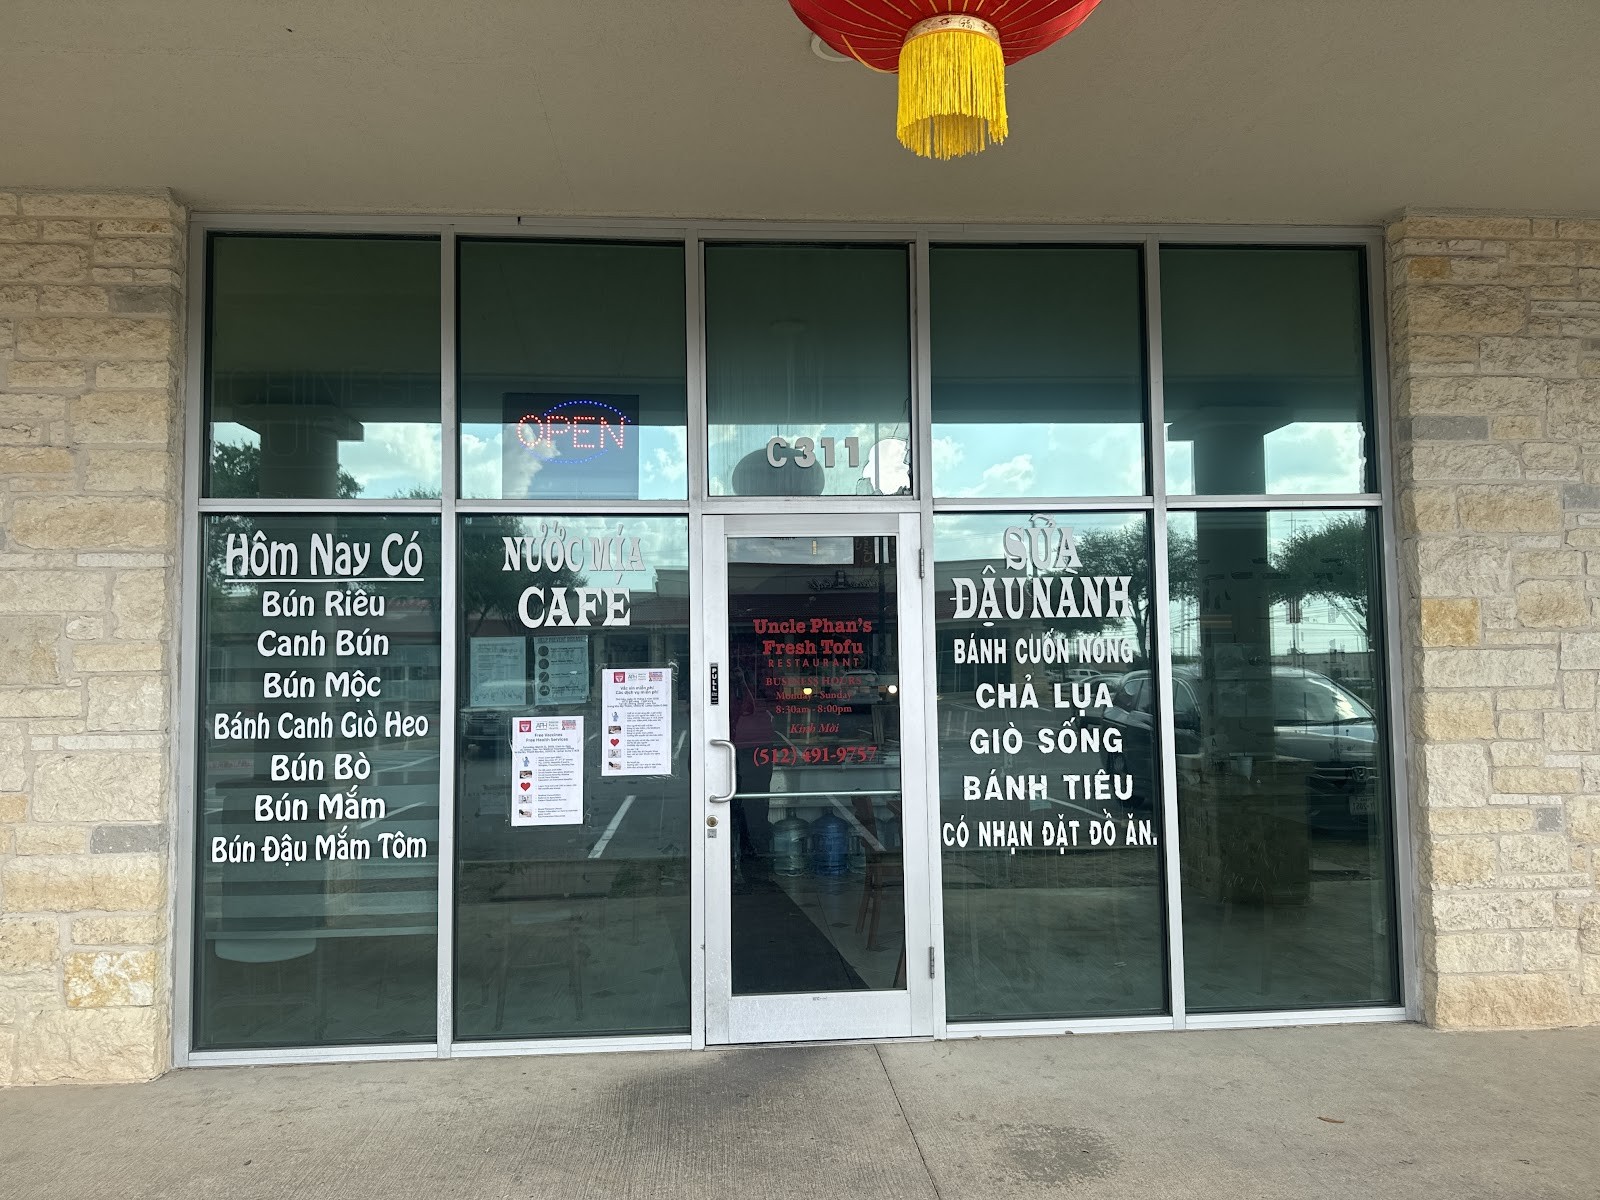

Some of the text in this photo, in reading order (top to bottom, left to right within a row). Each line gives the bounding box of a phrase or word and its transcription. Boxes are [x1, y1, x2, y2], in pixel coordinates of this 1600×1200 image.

[515, 413, 625, 450] OPEN
[226, 530, 423, 576] Hôm Nay Có
[502, 521, 646, 573] NƯỚC MÍA
[262, 589, 385, 617] Bún Riêu
[753, 618, 873, 634] Uncle Phan's
[257, 628, 389, 657] Canh Bún
[762, 639, 864, 655] Fresh Tofu
[953, 633, 1007, 664] BÁNH
[1015, 628, 1069, 664] CUỐN
[768, 657, 859, 668] RESTAURANT
[263, 670, 381, 703] Bún Mộc
[766, 676, 862, 686] BUSINESS HOURS
[776, 691, 812, 702] Monday
[819, 690, 852, 701] Sunday
[975, 674, 1113, 716] CHẢ LỤA
[214, 710, 429, 739] Bánh Canh Giò Heo
[776, 705, 810, 714] 8:30am
[817, 704, 852, 715] 8:00pm
[969, 717, 1123, 754] GIÒ SỐNG
[271, 752, 371, 781] Bún Bò
[753, 746, 878, 767] (512) 491-9757
[963, 769, 1133, 801] BÁNH TIÊU
[254, 784, 386, 822] Bún Mắm
[211, 825, 427, 867] Bún Đậu Mắm Tôm
[942, 815, 970, 848] CÓ
[1042, 813, 1080, 855] ĐẶT
[1089, 808, 1116, 847] ĐỒ
